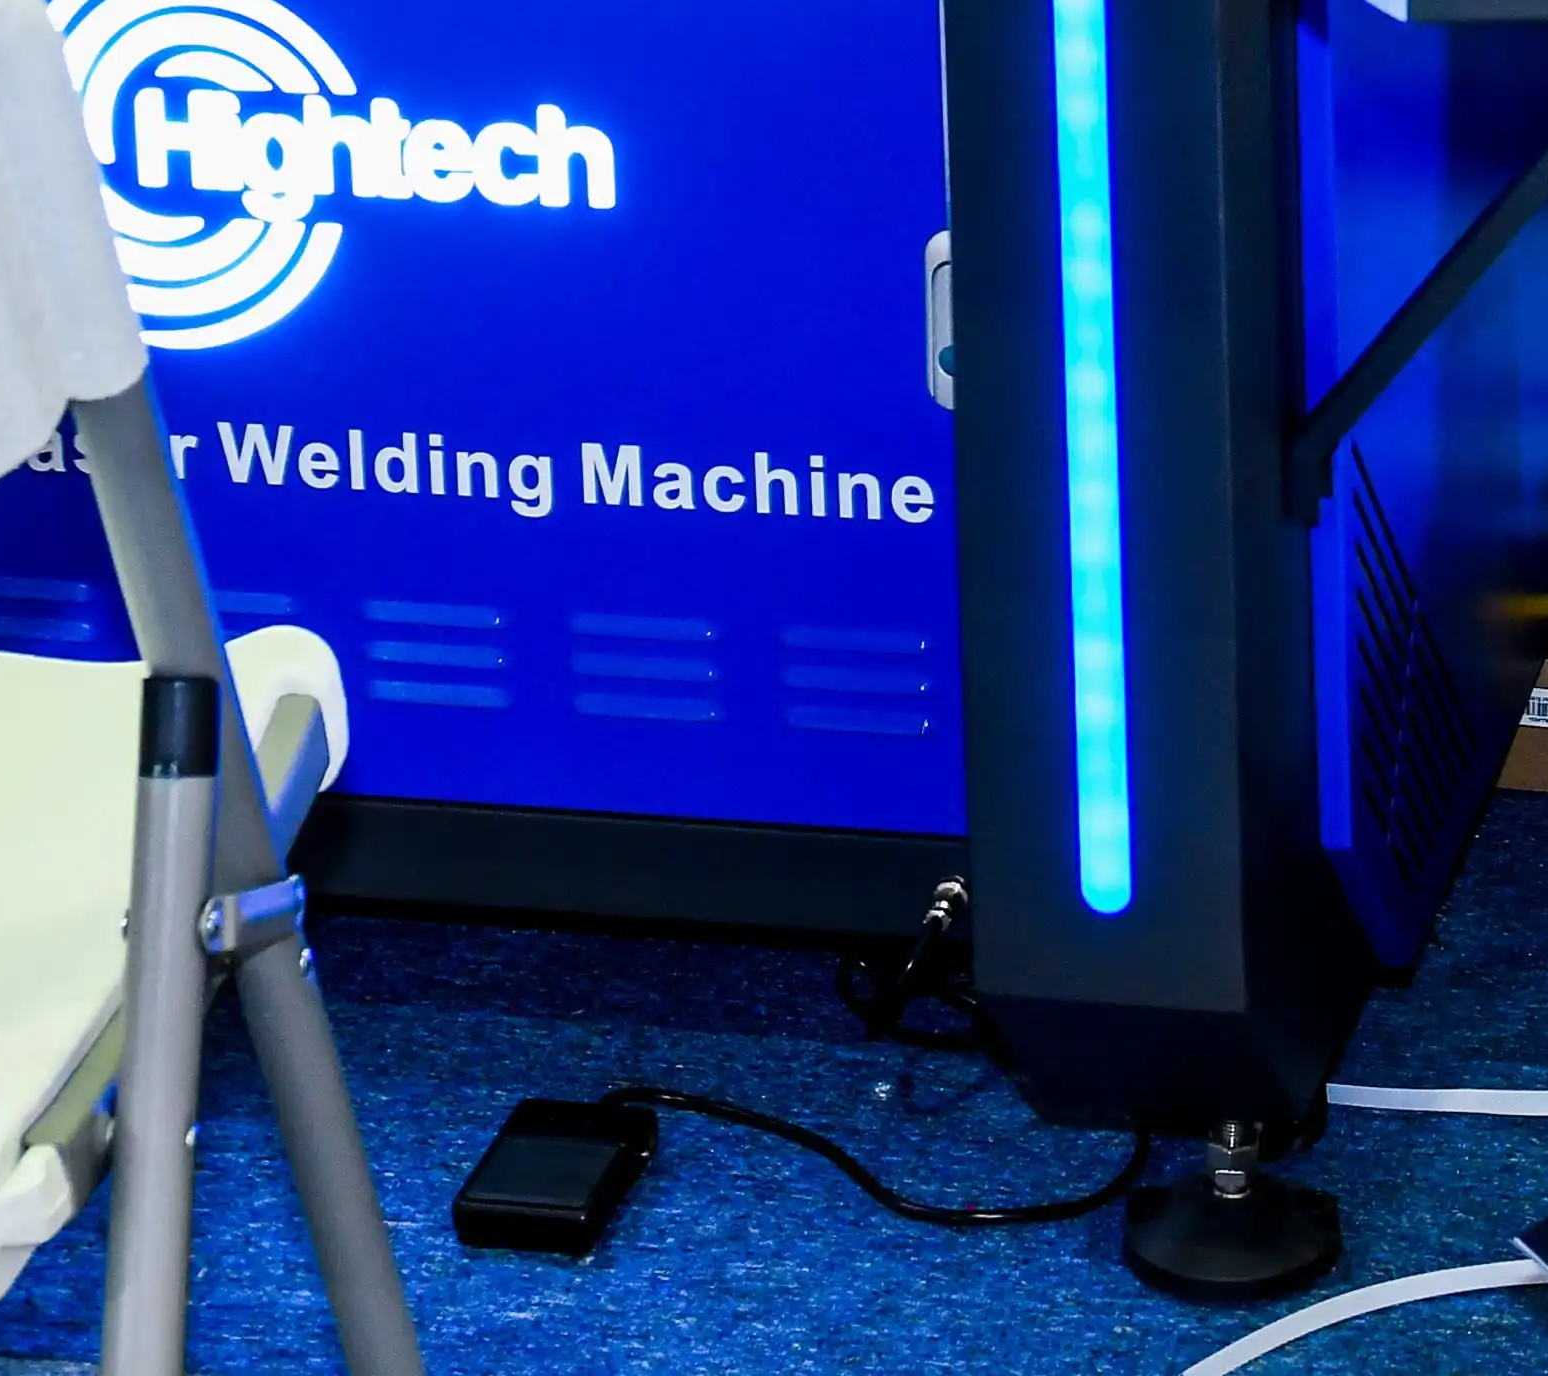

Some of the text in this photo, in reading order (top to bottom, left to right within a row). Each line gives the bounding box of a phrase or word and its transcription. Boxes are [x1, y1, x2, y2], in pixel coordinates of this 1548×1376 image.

[135, 86, 618, 220] Hightech
[216, 421, 555, 517] Welding
[580, 441, 935, 523] Machine
